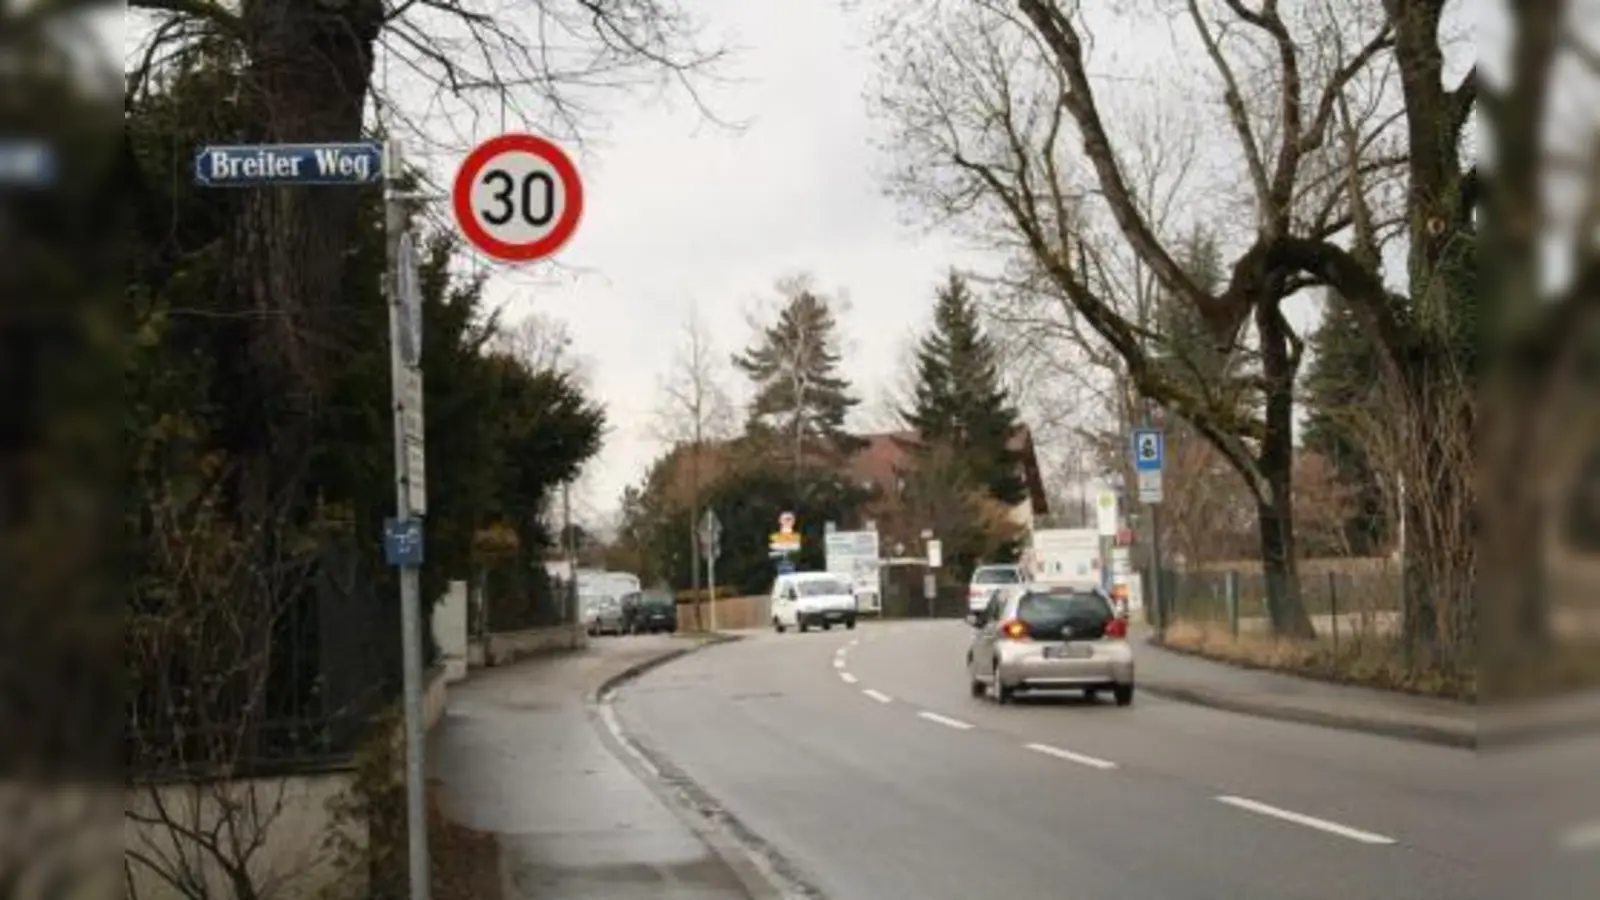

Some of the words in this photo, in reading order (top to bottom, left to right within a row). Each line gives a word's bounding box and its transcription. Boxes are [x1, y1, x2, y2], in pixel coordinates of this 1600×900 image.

[210, 149, 302, 178] Breiter
[314, 148, 371, 182] Weg
[480, 169, 555, 227] 30
